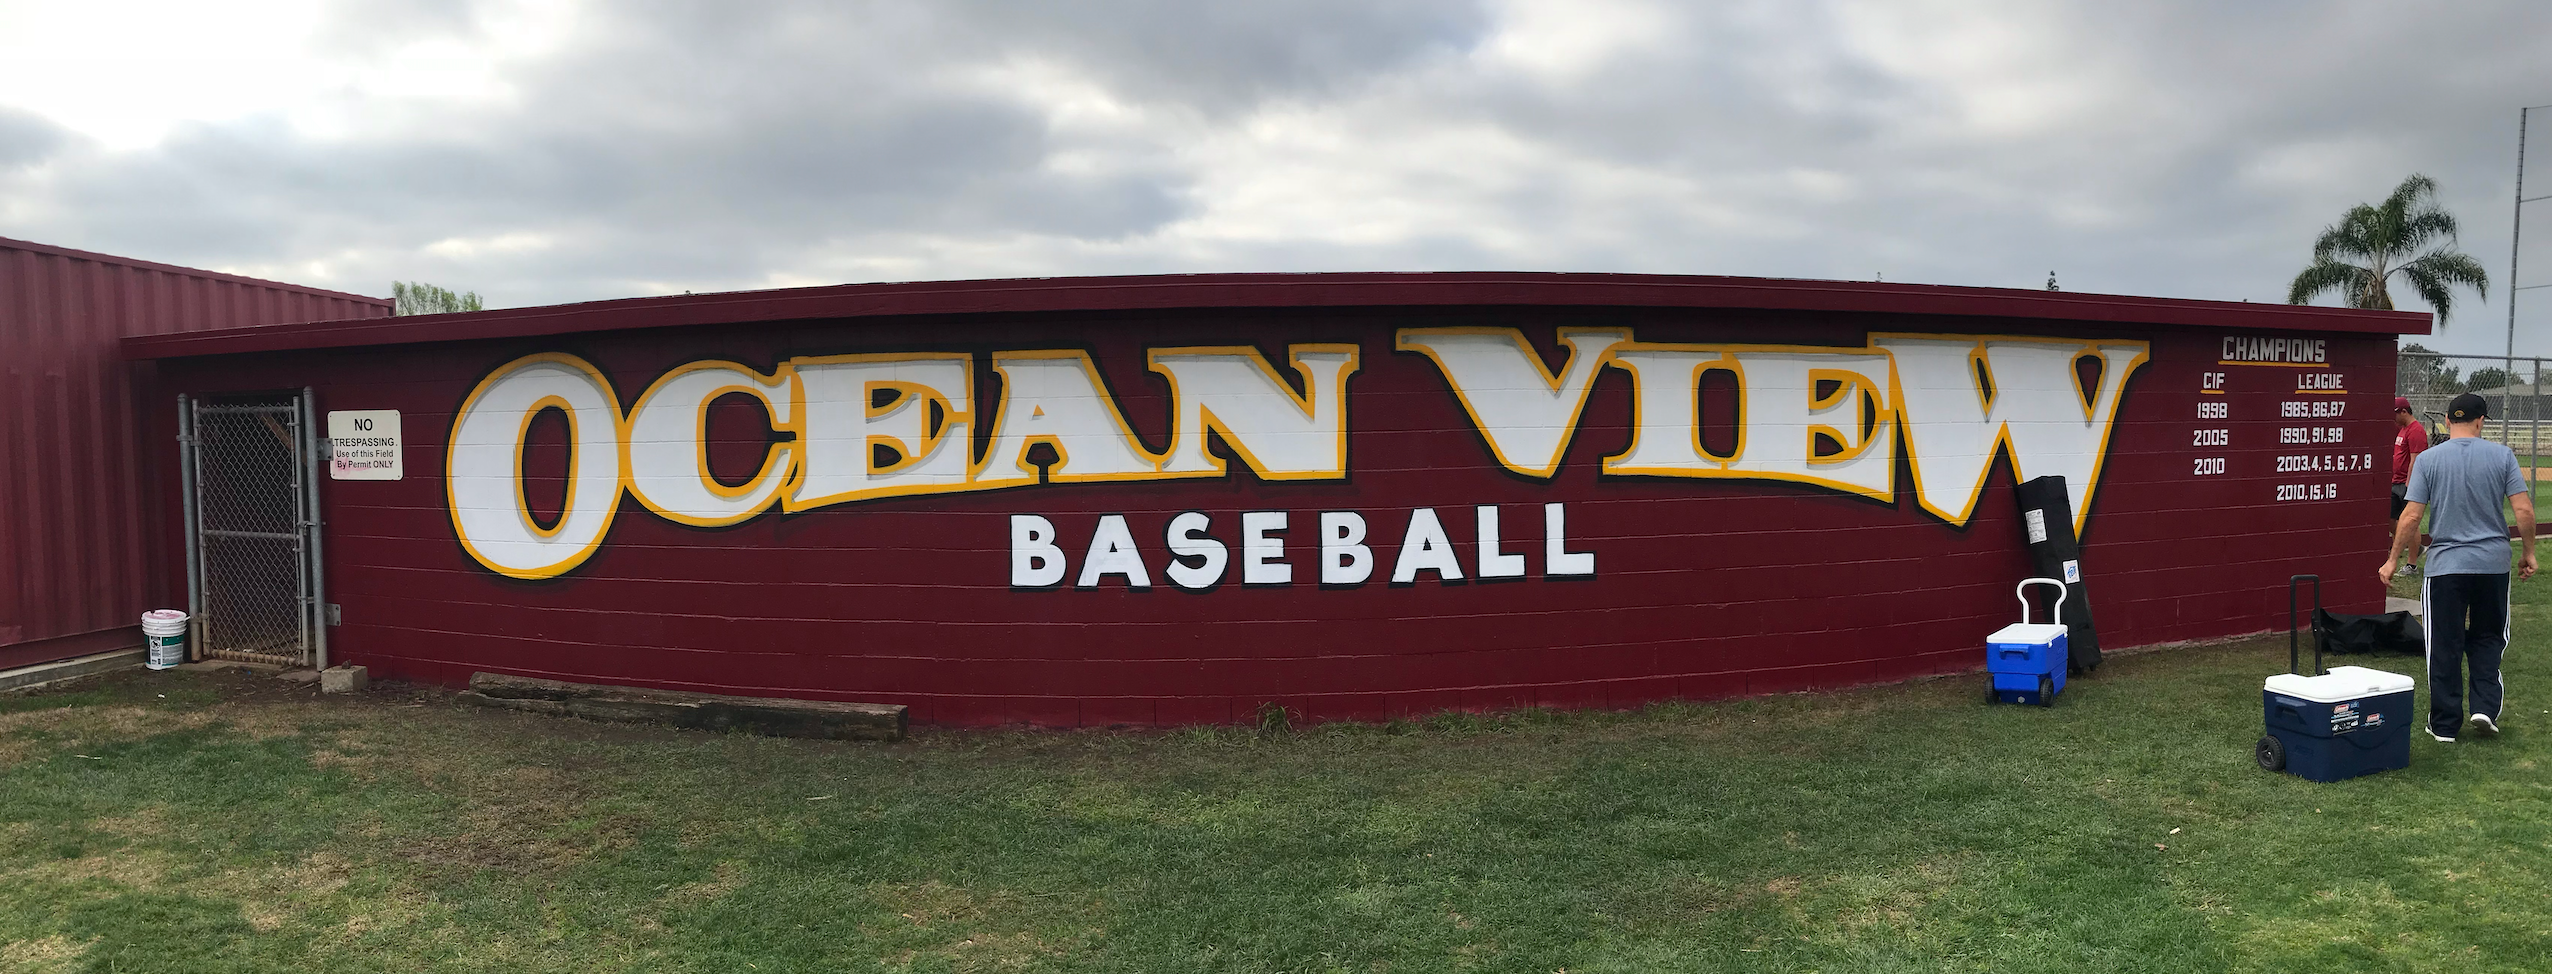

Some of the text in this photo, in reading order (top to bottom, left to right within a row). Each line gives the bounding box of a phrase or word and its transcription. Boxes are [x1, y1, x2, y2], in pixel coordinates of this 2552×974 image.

[2222, 336, 2326, 363] CHAMPIONS
[2203, 372, 2225, 389] CIF
[2297, 373, 2344, 389] LEAGUE
[2197, 402, 2228, 419] 1998
[354, 418, 373, 431] NO
[334, 437, 395, 447] TRESPASSING
[2193, 429, 2229, 446] 2005
[336, 449, 394, 458] Use of this Field
[446, 327, 2150, 580] OCEAN VIEW
[337, 460, 394, 470] By Permit ONLY
[2194, 458, 2226, 475] 2010
[1011, 503, 1596, 589] BASEBALL
